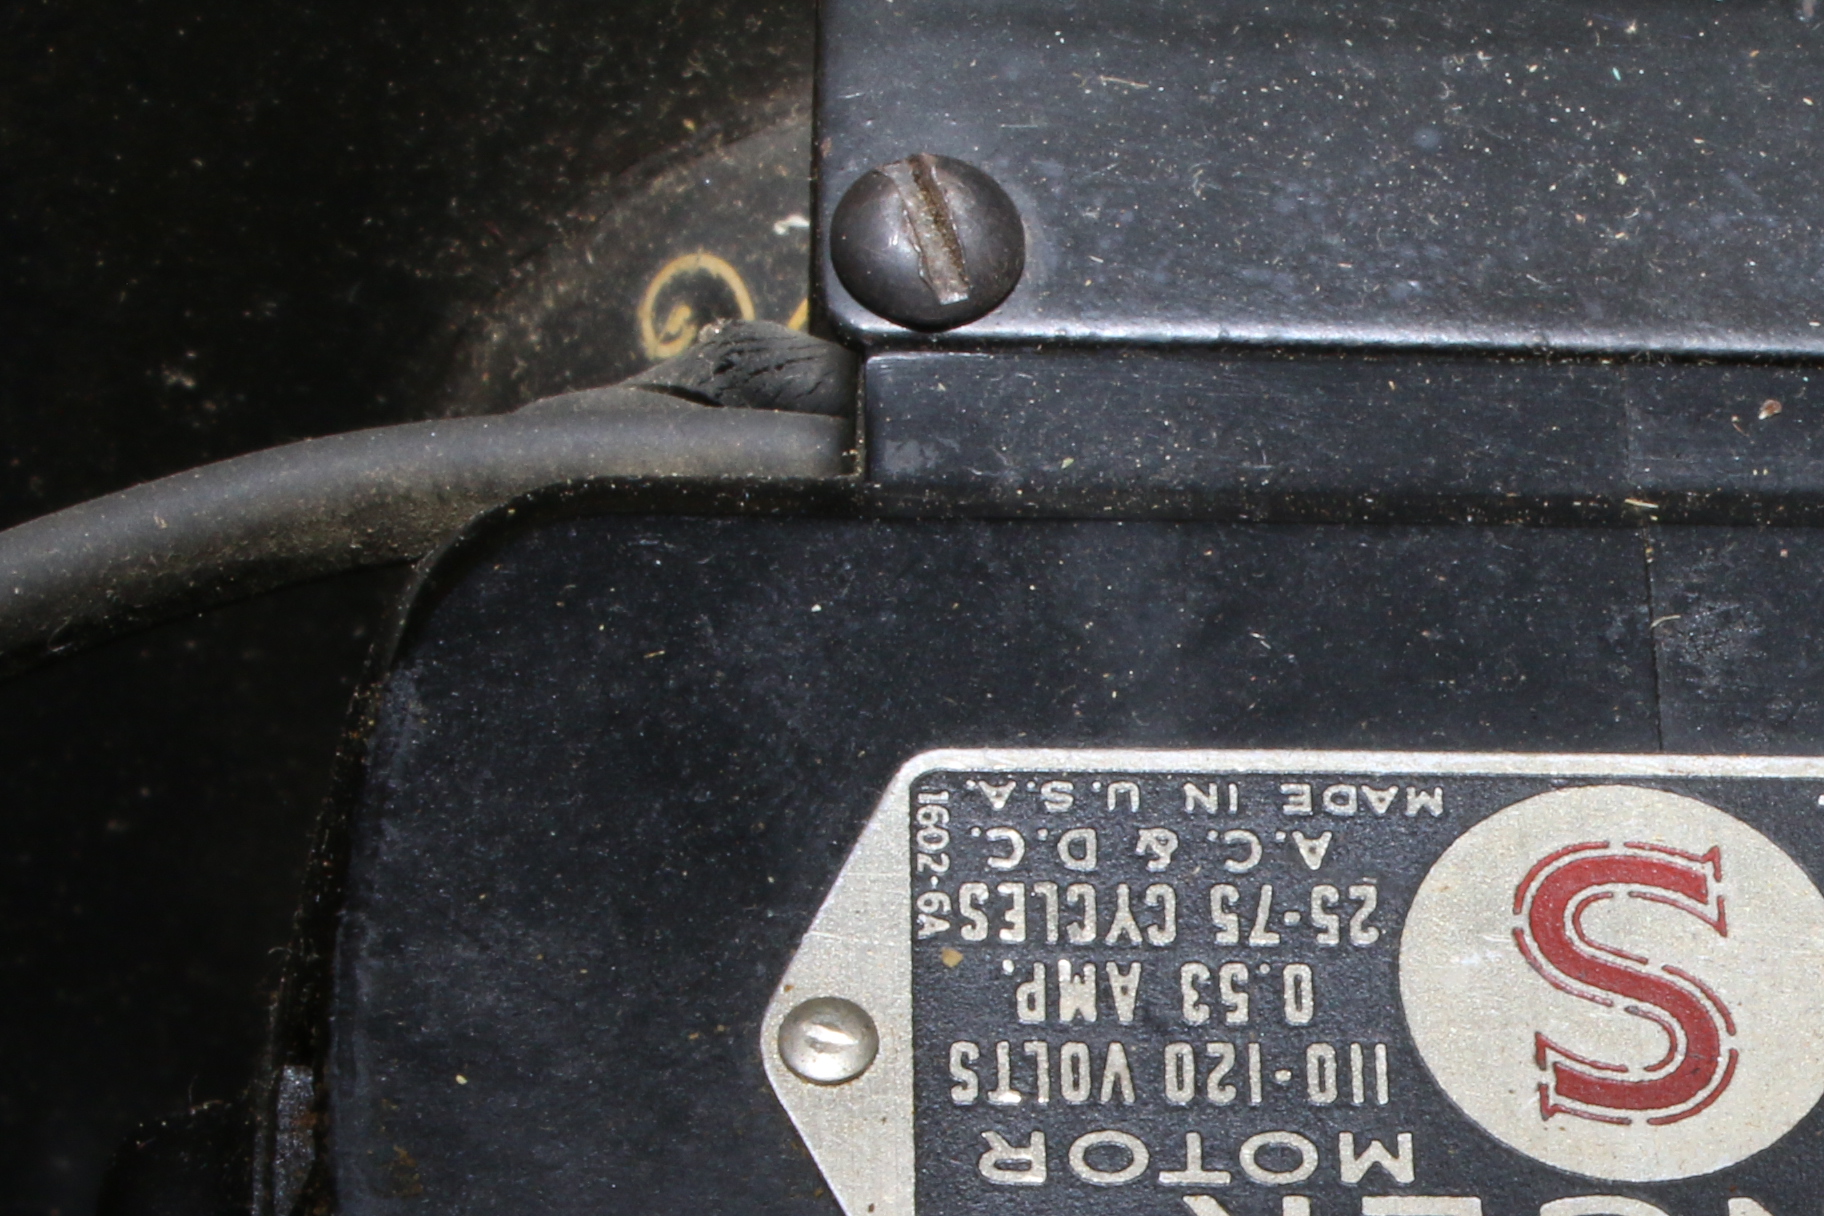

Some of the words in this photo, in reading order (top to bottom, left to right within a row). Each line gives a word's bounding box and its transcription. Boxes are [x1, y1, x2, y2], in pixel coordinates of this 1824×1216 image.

[1183, 782, 1239, 813] IN
[1279, 783, 1444, 818] MADE
[916, 788, 951, 940] 1602-6A
[1135, 827, 1179, 872] &
[958, 881, 1178, 946] CYCLES
[1209, 882, 1381, 947] 25-75
[1001, 959, 1142, 1024] AMP.
[1180, 962, 1314, 1025] 0.53
[1512, 842, 1738, 1127] S
[948, 1041, 1135, 1105] VOLTS
[1164, 1042, 1390, 1106] 110-120
[978, 1131, 1415, 1186] MOTOR
